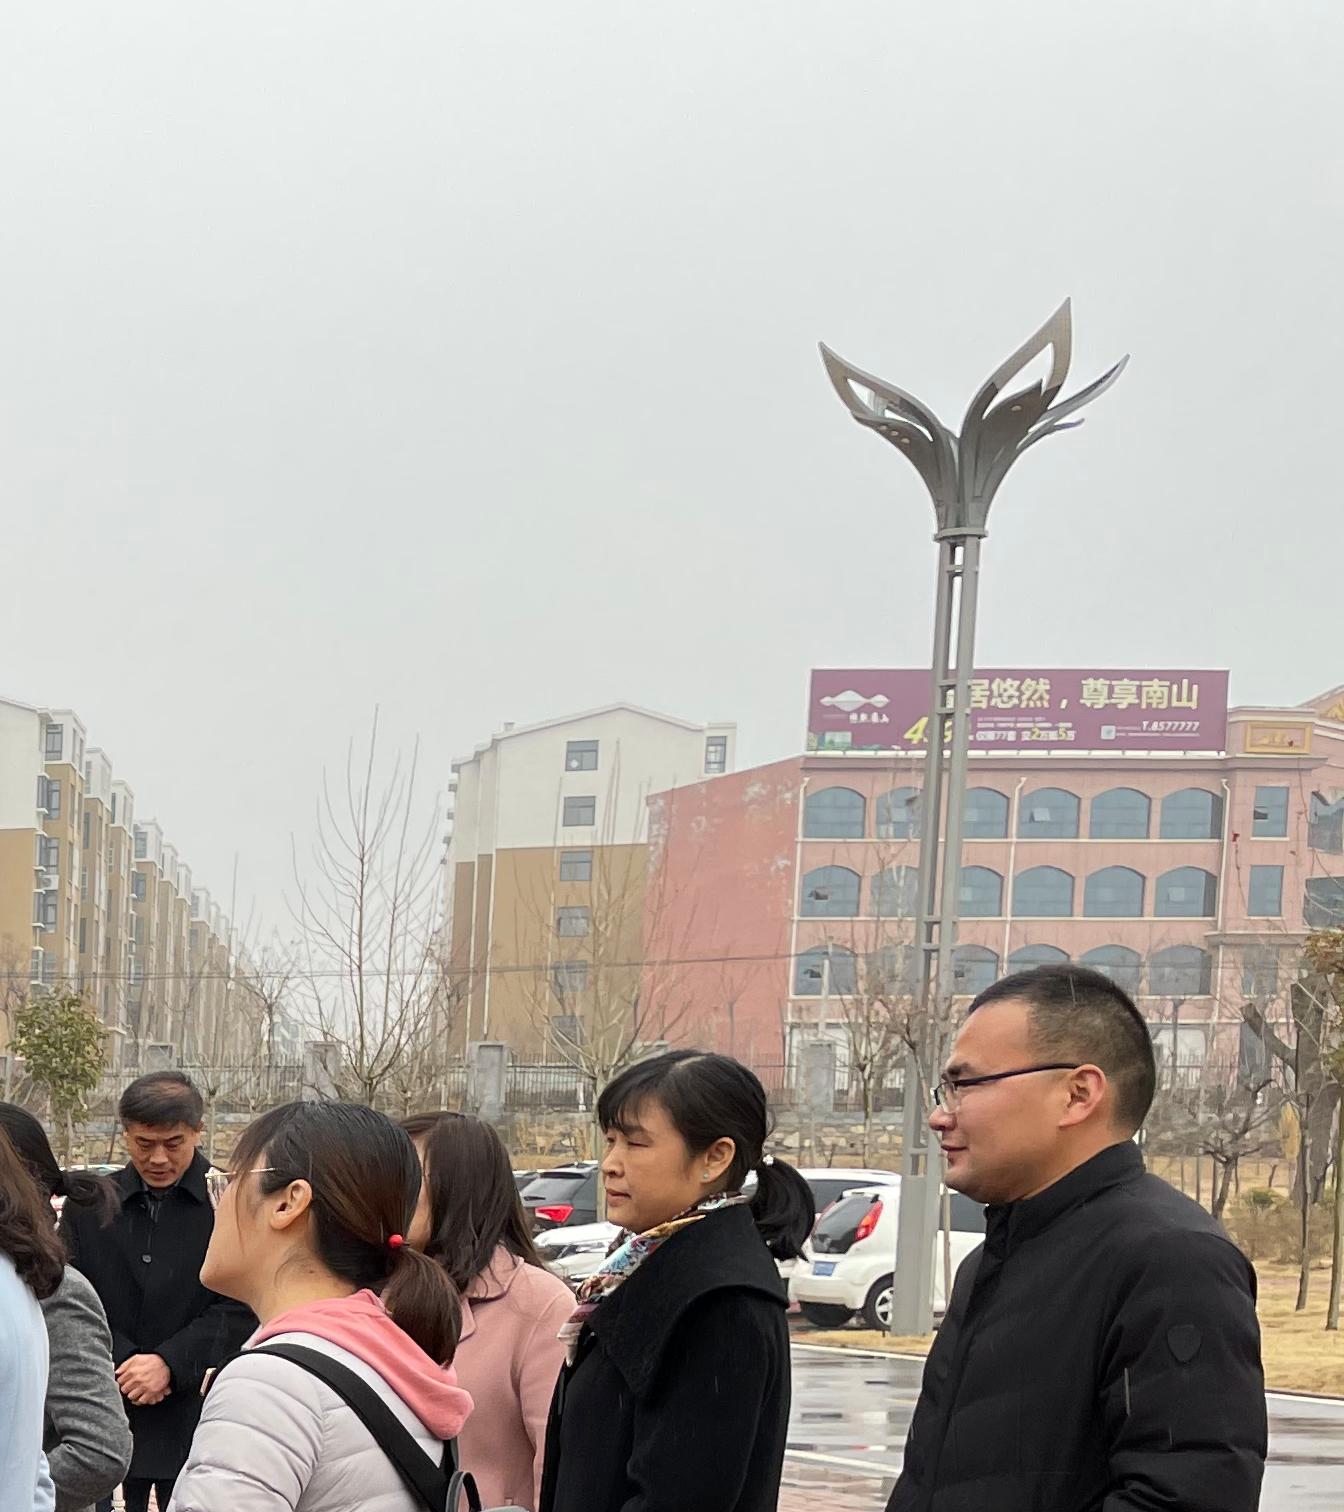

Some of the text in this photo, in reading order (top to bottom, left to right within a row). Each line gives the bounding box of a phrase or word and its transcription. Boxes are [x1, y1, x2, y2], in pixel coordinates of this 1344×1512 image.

[946, 676, 1199, 709] 居悠然，尊享南山
